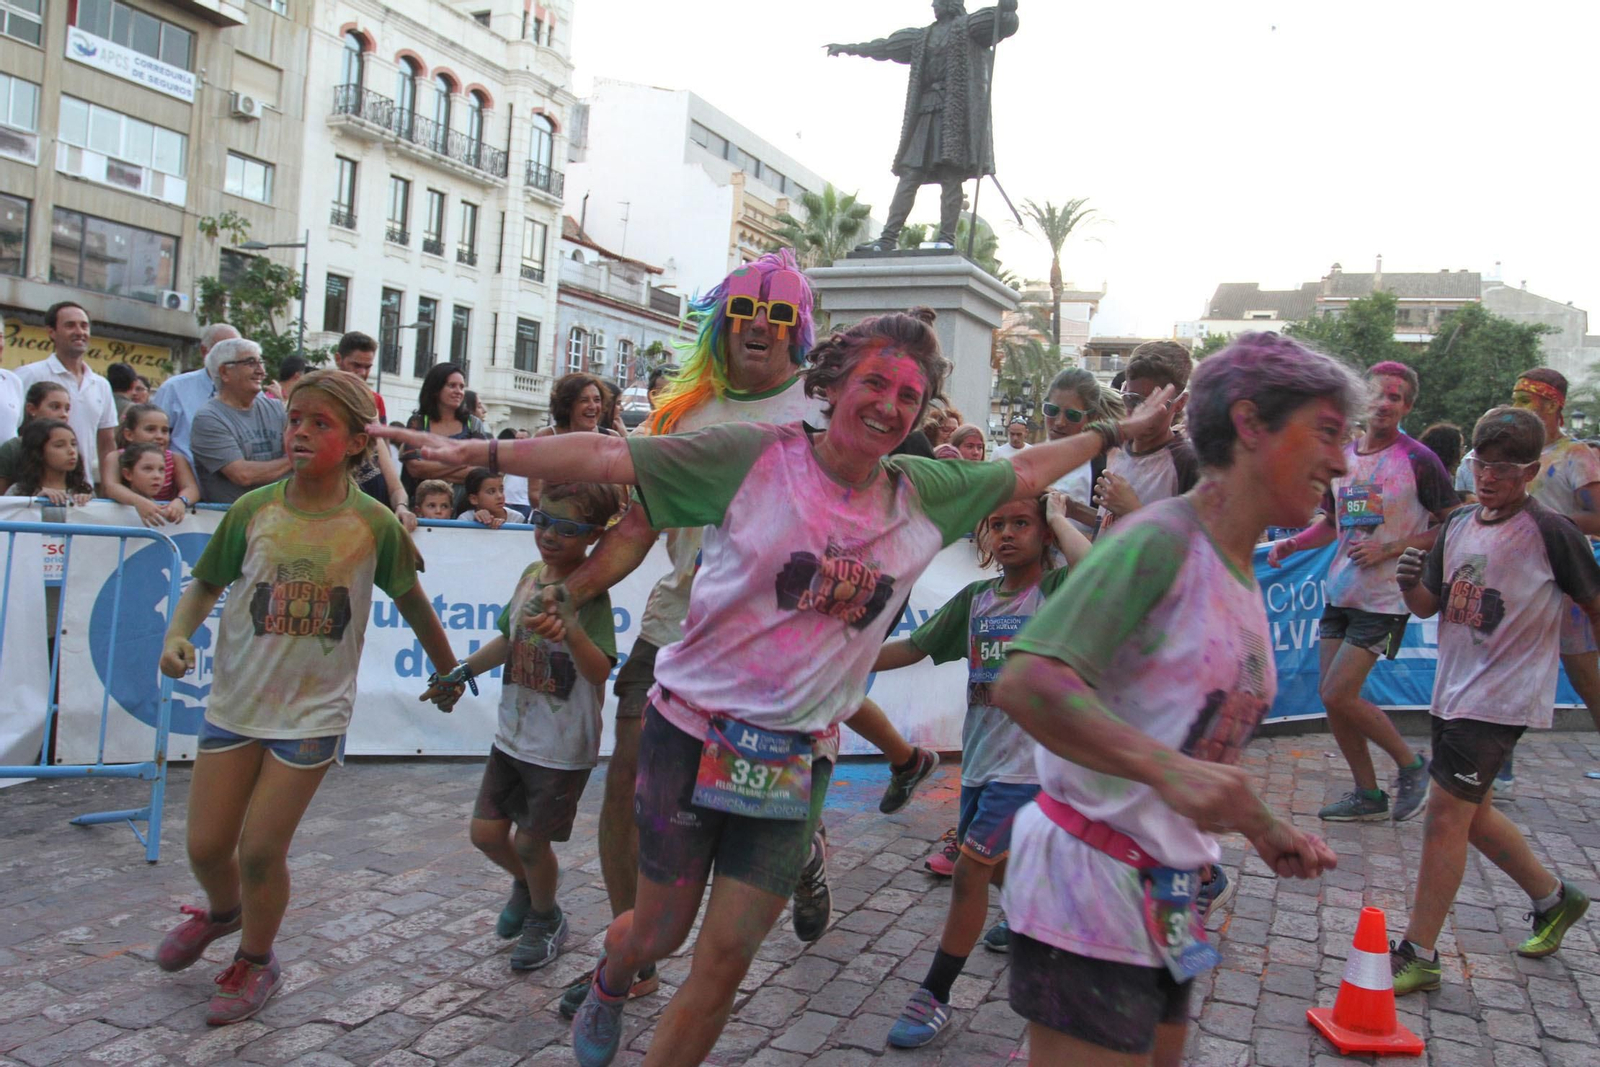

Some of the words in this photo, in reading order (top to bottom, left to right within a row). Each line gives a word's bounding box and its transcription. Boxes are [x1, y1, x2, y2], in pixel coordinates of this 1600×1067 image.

[101, 48, 130, 71] APCS
[134, 57, 192, 85] CORREDURÍA
[132, 69, 145, 80] DE
[148, 74, 192, 97] SEGUROS
[1347, 499, 1368, 512] 857
[821, 555, 879, 590] MUSIC
[273, 581, 332, 602] MUSIC
[264, 614, 334, 636] COLORS
[731, 758, 784, 791] 337
